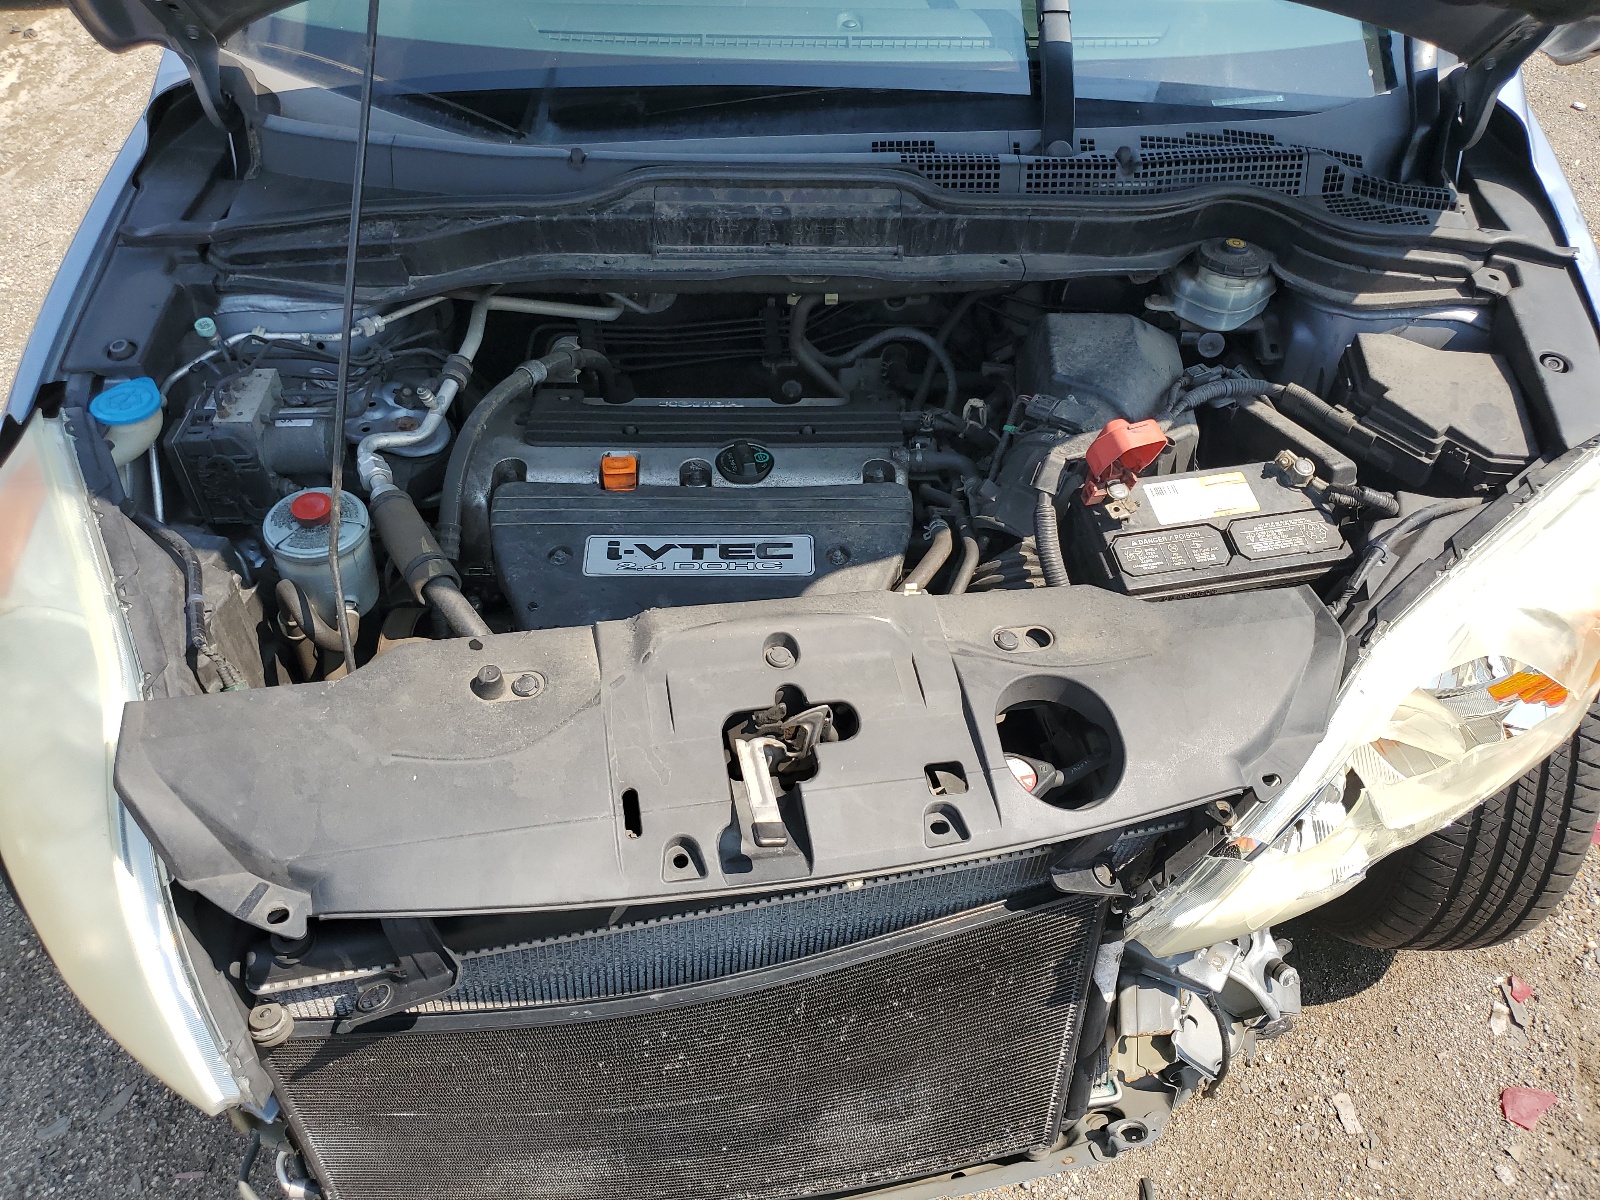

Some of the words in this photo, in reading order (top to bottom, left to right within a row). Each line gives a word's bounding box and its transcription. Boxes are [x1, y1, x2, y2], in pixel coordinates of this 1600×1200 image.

[1137, 536, 1168, 546] DANGER
[1174, 531, 1201, 541] POISON
[606, 540, 794, 561] i-VTEC
[615, 562, 667, 571] 2.4
[672, 561, 783, 571] DOHC
